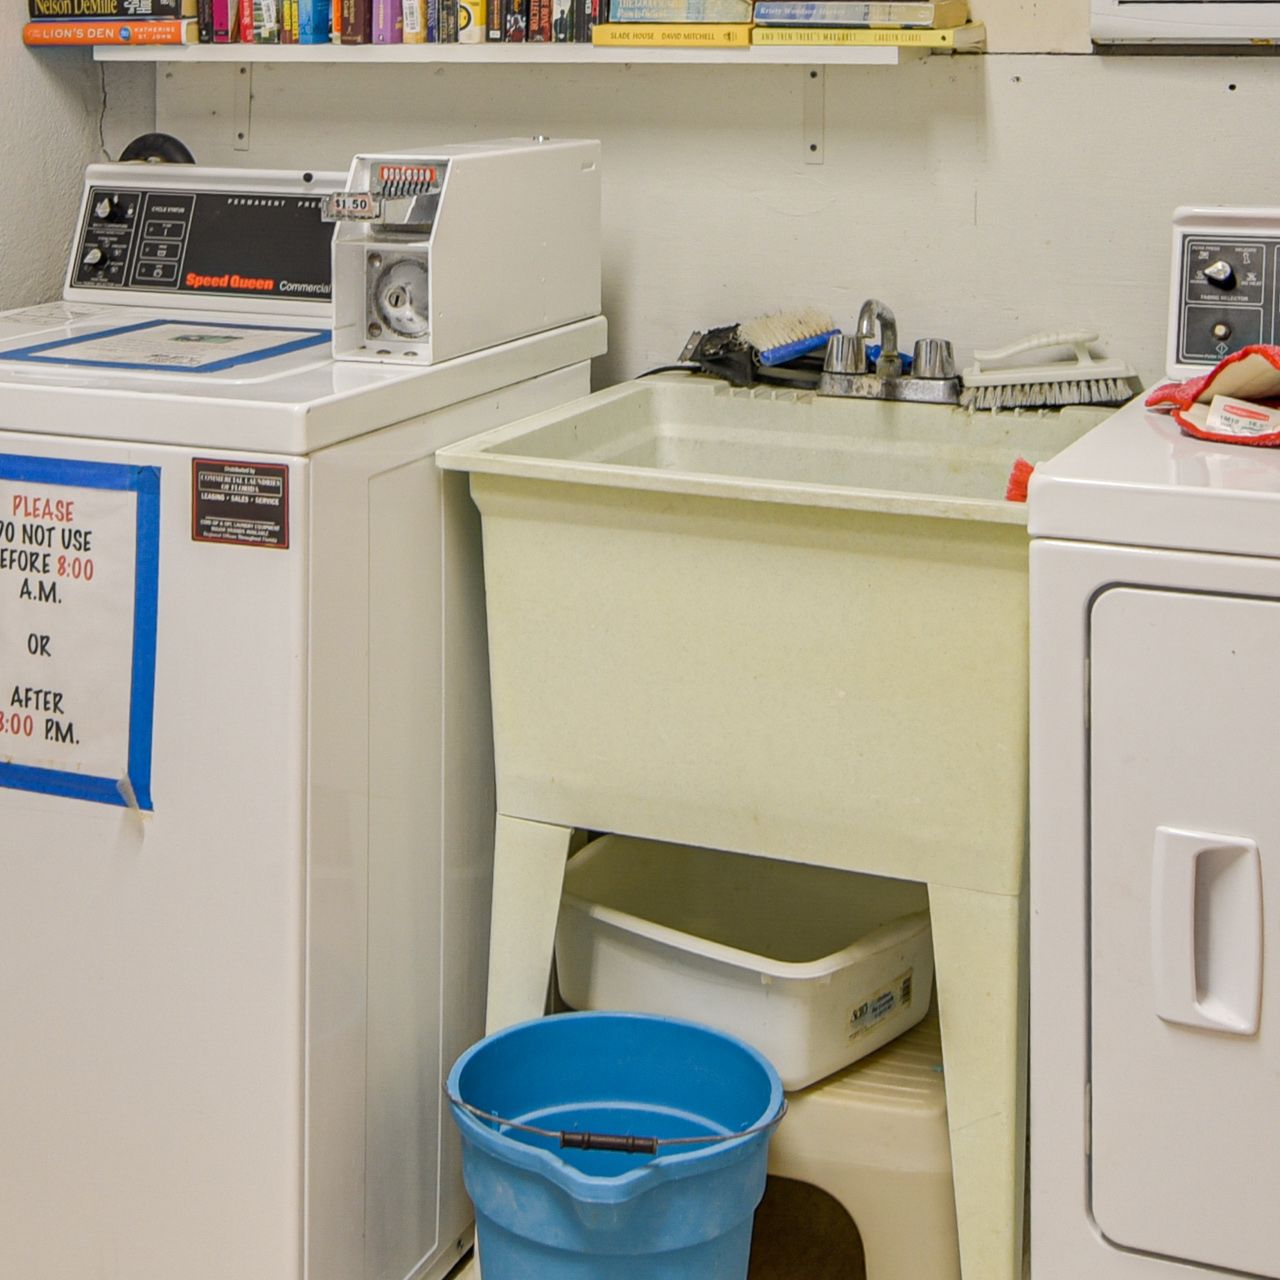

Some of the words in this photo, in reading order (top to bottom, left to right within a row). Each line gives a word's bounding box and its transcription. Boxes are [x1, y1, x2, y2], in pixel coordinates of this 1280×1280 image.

[43, 28, 84, 39] LION'S
[87, 28, 114, 38] DEN
[610, 32, 631, 40] SLADE
[633, 32, 654, 40] HOUSE
[661, 32, 681, 40] DAVID
[683, 32, 715, 40] MITCHELL
[823, 33, 857, 41] MARGARET
[227, 198, 286, 208] PERMANENT
[335, 199, 367, 210] $1.50
[185, 271, 230, 289] Speed
[230, 274, 274, 291] Queen
[279, 280, 332, 294] Commercial
[13, 494, 74, 522] PLEASE
[201, 492, 225, 501] LEASING
[231, 495, 249, 503] SALES
[255, 496, 279, 506] SERVICE
[22, 525, 53, 549] NOT
[61, 528, 92, 551] USE
[57, 556, 94, 581] 8:00
[20, 578, 62, 604] A.M.
[27, 633, 52, 657] OR
[10, 686, 64, 714] AFTER
[44, 718, 80, 745] P.M.
